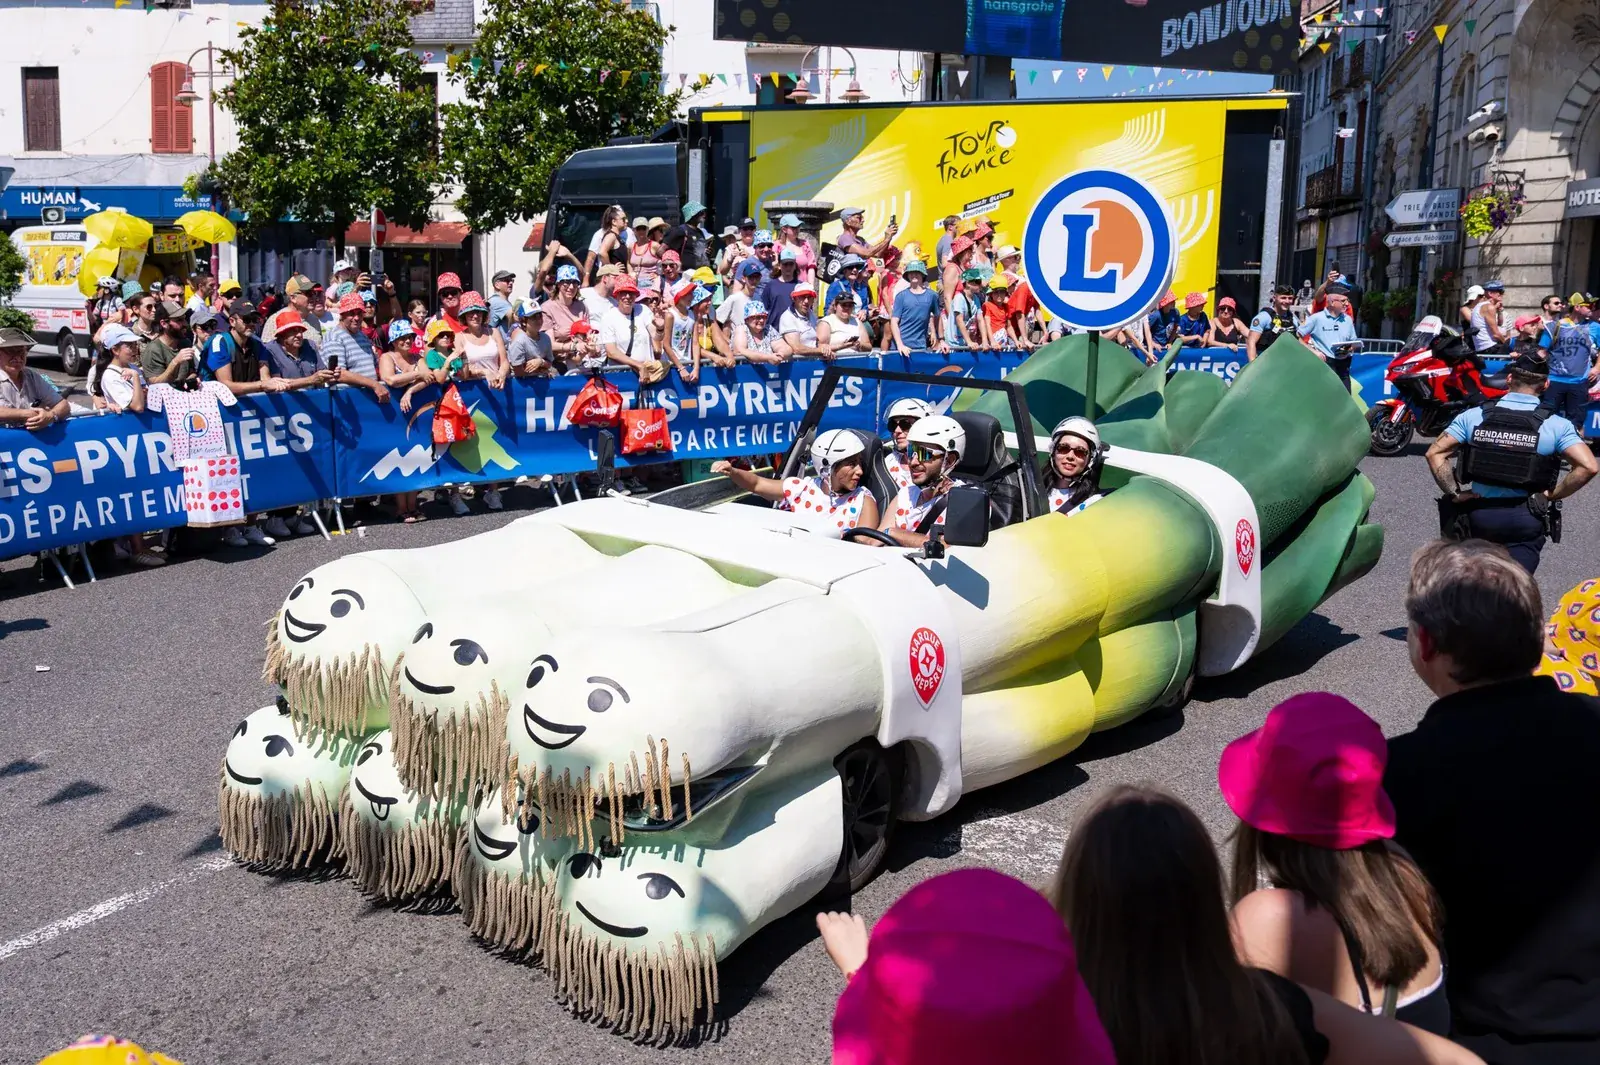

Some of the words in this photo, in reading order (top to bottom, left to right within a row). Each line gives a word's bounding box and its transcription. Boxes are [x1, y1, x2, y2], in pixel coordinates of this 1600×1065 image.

[20, 191, 76, 205] HUMAN
[1403, 204, 1421, 212] TRIE
[1418, 210, 1455, 219] MIRANDE
[1058, 213, 1117, 294] L
[1558, 336, 1587, 347] HOTO
[1474, 429, 1537, 443] GENDARMERIE
[911, 630, 940, 658] MARQUE
